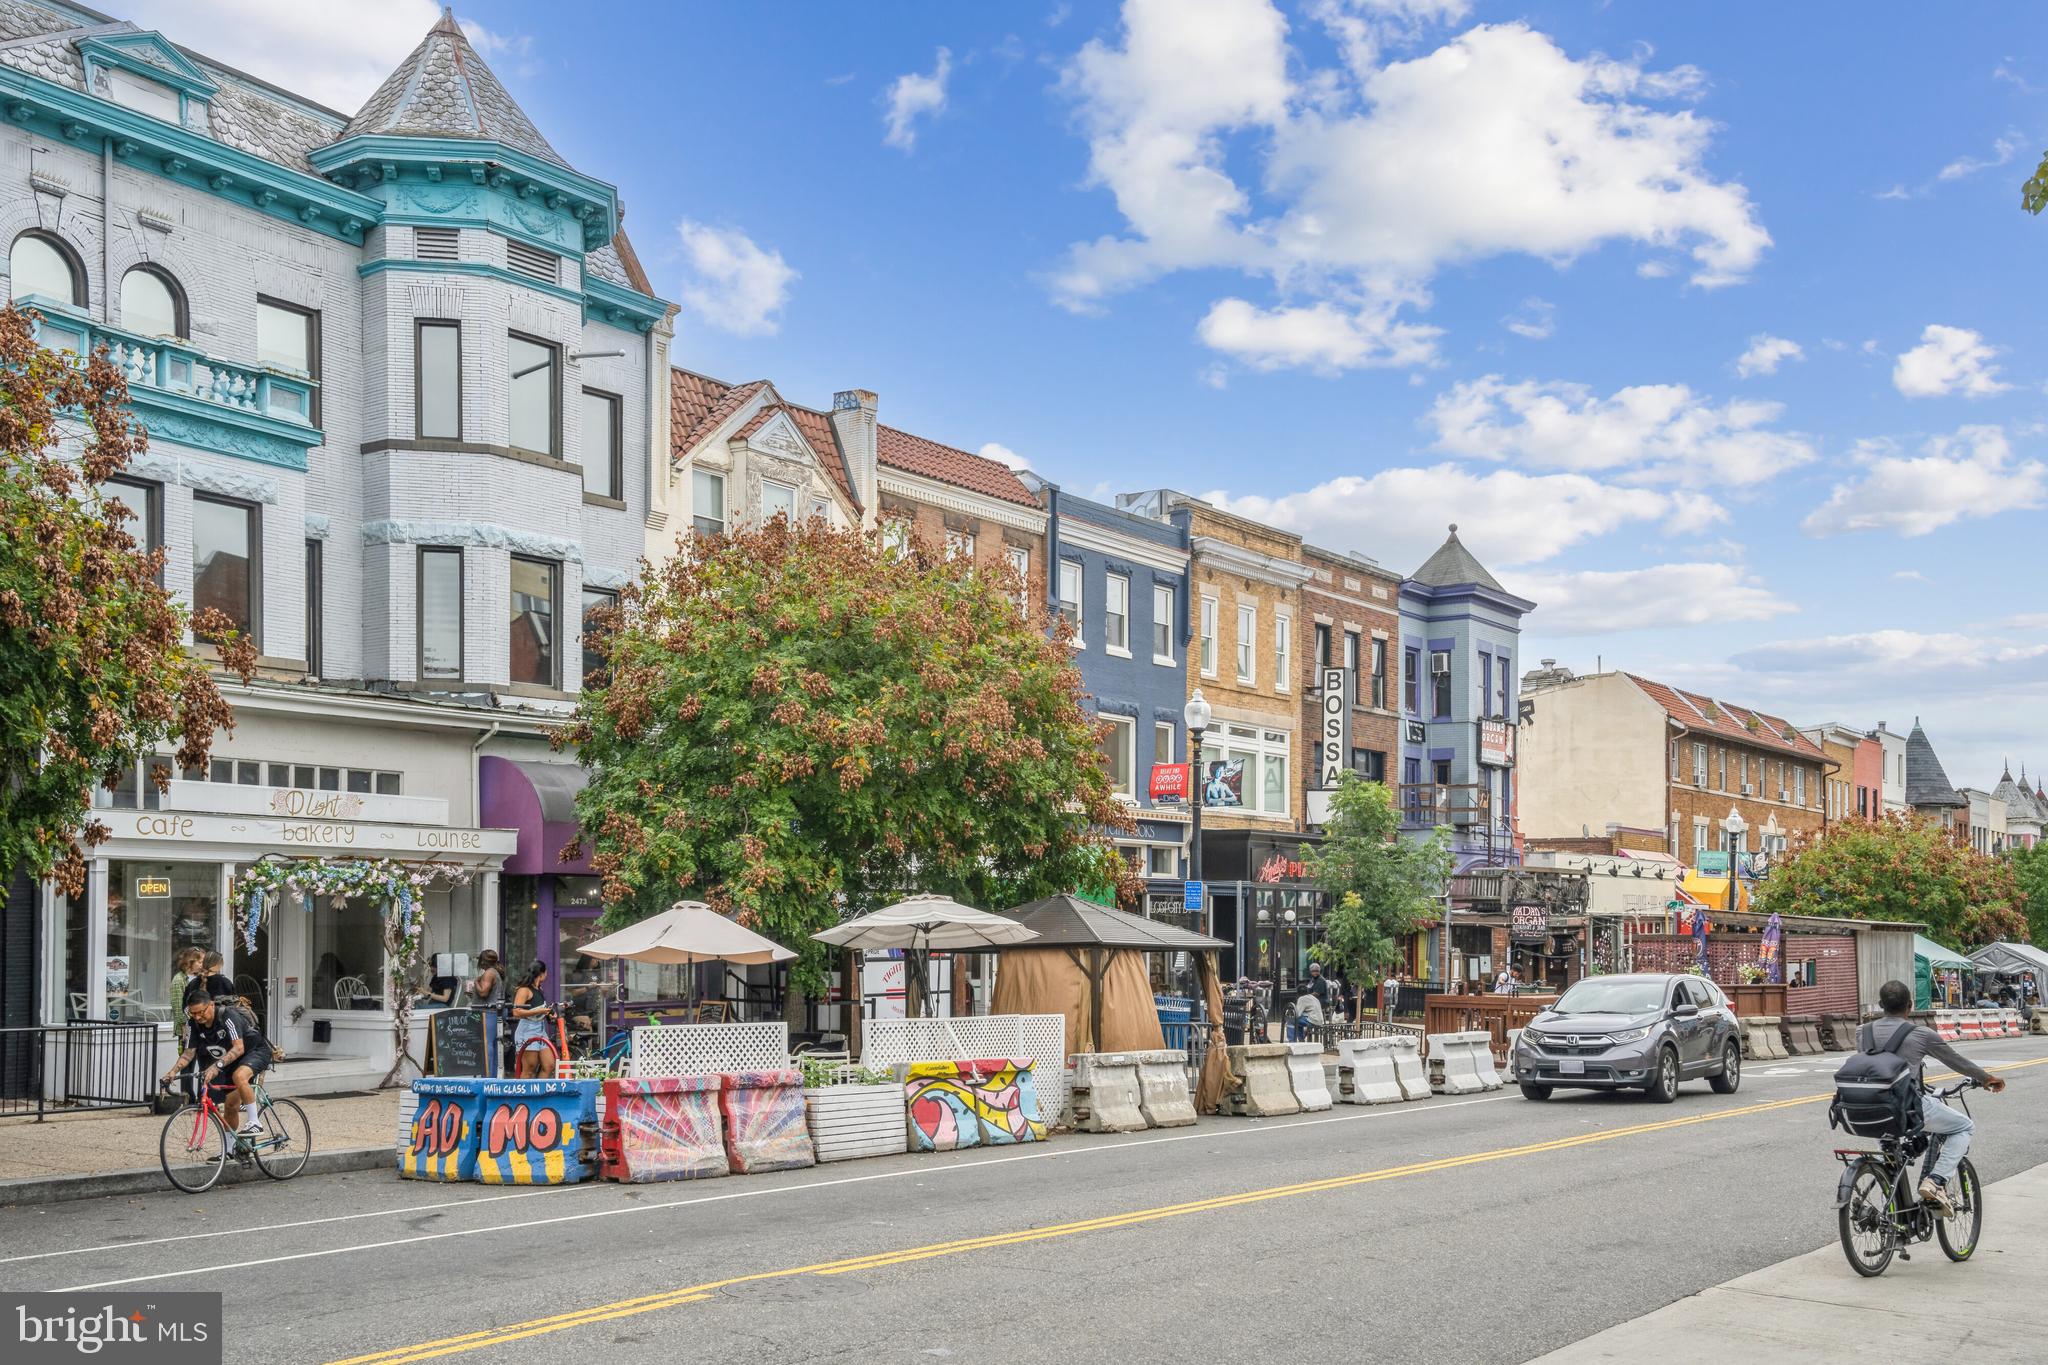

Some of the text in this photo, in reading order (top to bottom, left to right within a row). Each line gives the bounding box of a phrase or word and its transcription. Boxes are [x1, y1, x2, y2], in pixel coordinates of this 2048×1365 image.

[1325, 672, 1342, 785] BOSSA
[1155, 783, 1182, 791] AWHILE
[282, 823, 355, 845] bakery
[140, 883, 167, 893] OPEN
[1513, 916, 1546, 926] ORGAN
[484, 1084, 501, 1094] MATH
[503, 1084, 526, 1094] CLASS
[530, 1083, 540, 1093] IN
[489, 1104, 562, 1159] MO
